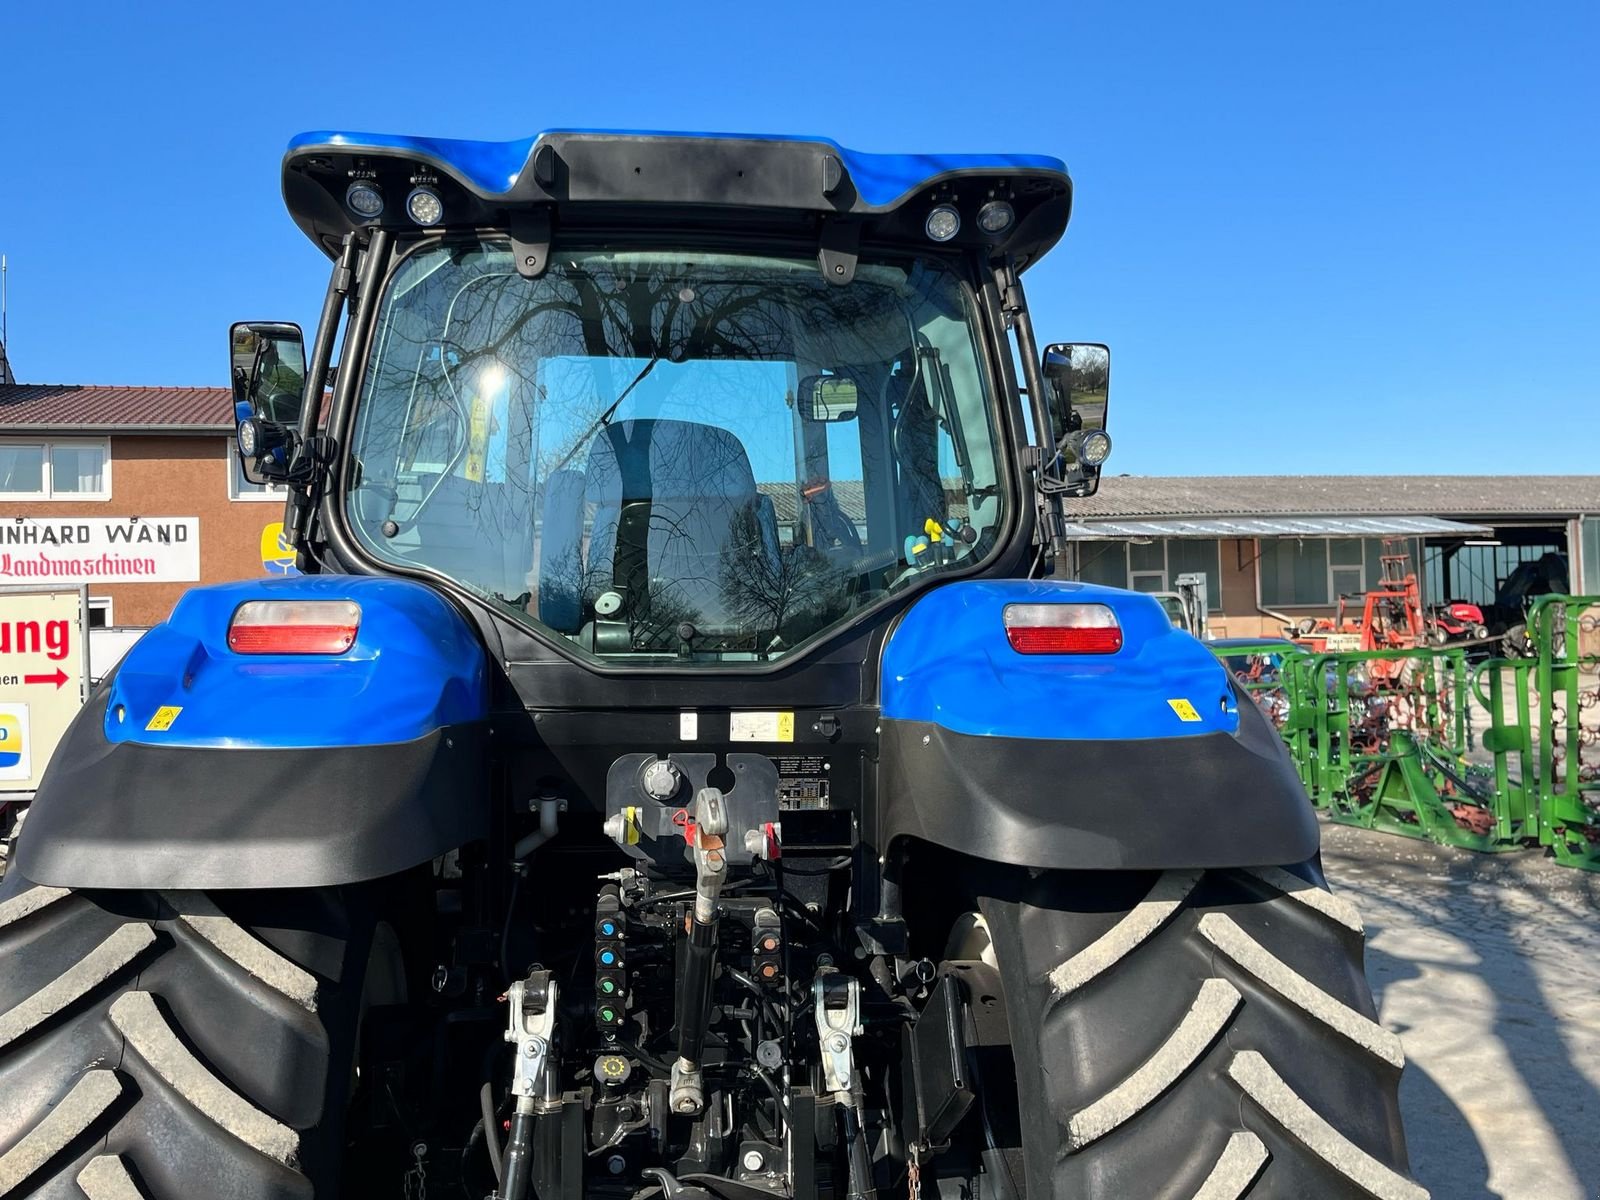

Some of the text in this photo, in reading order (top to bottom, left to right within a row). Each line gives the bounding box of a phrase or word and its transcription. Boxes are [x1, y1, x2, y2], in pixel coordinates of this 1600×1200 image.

[105, 524, 187, 543] WAND
[0, 552, 156, 576] Landmaschinen
[0, 675, 19, 685] en
